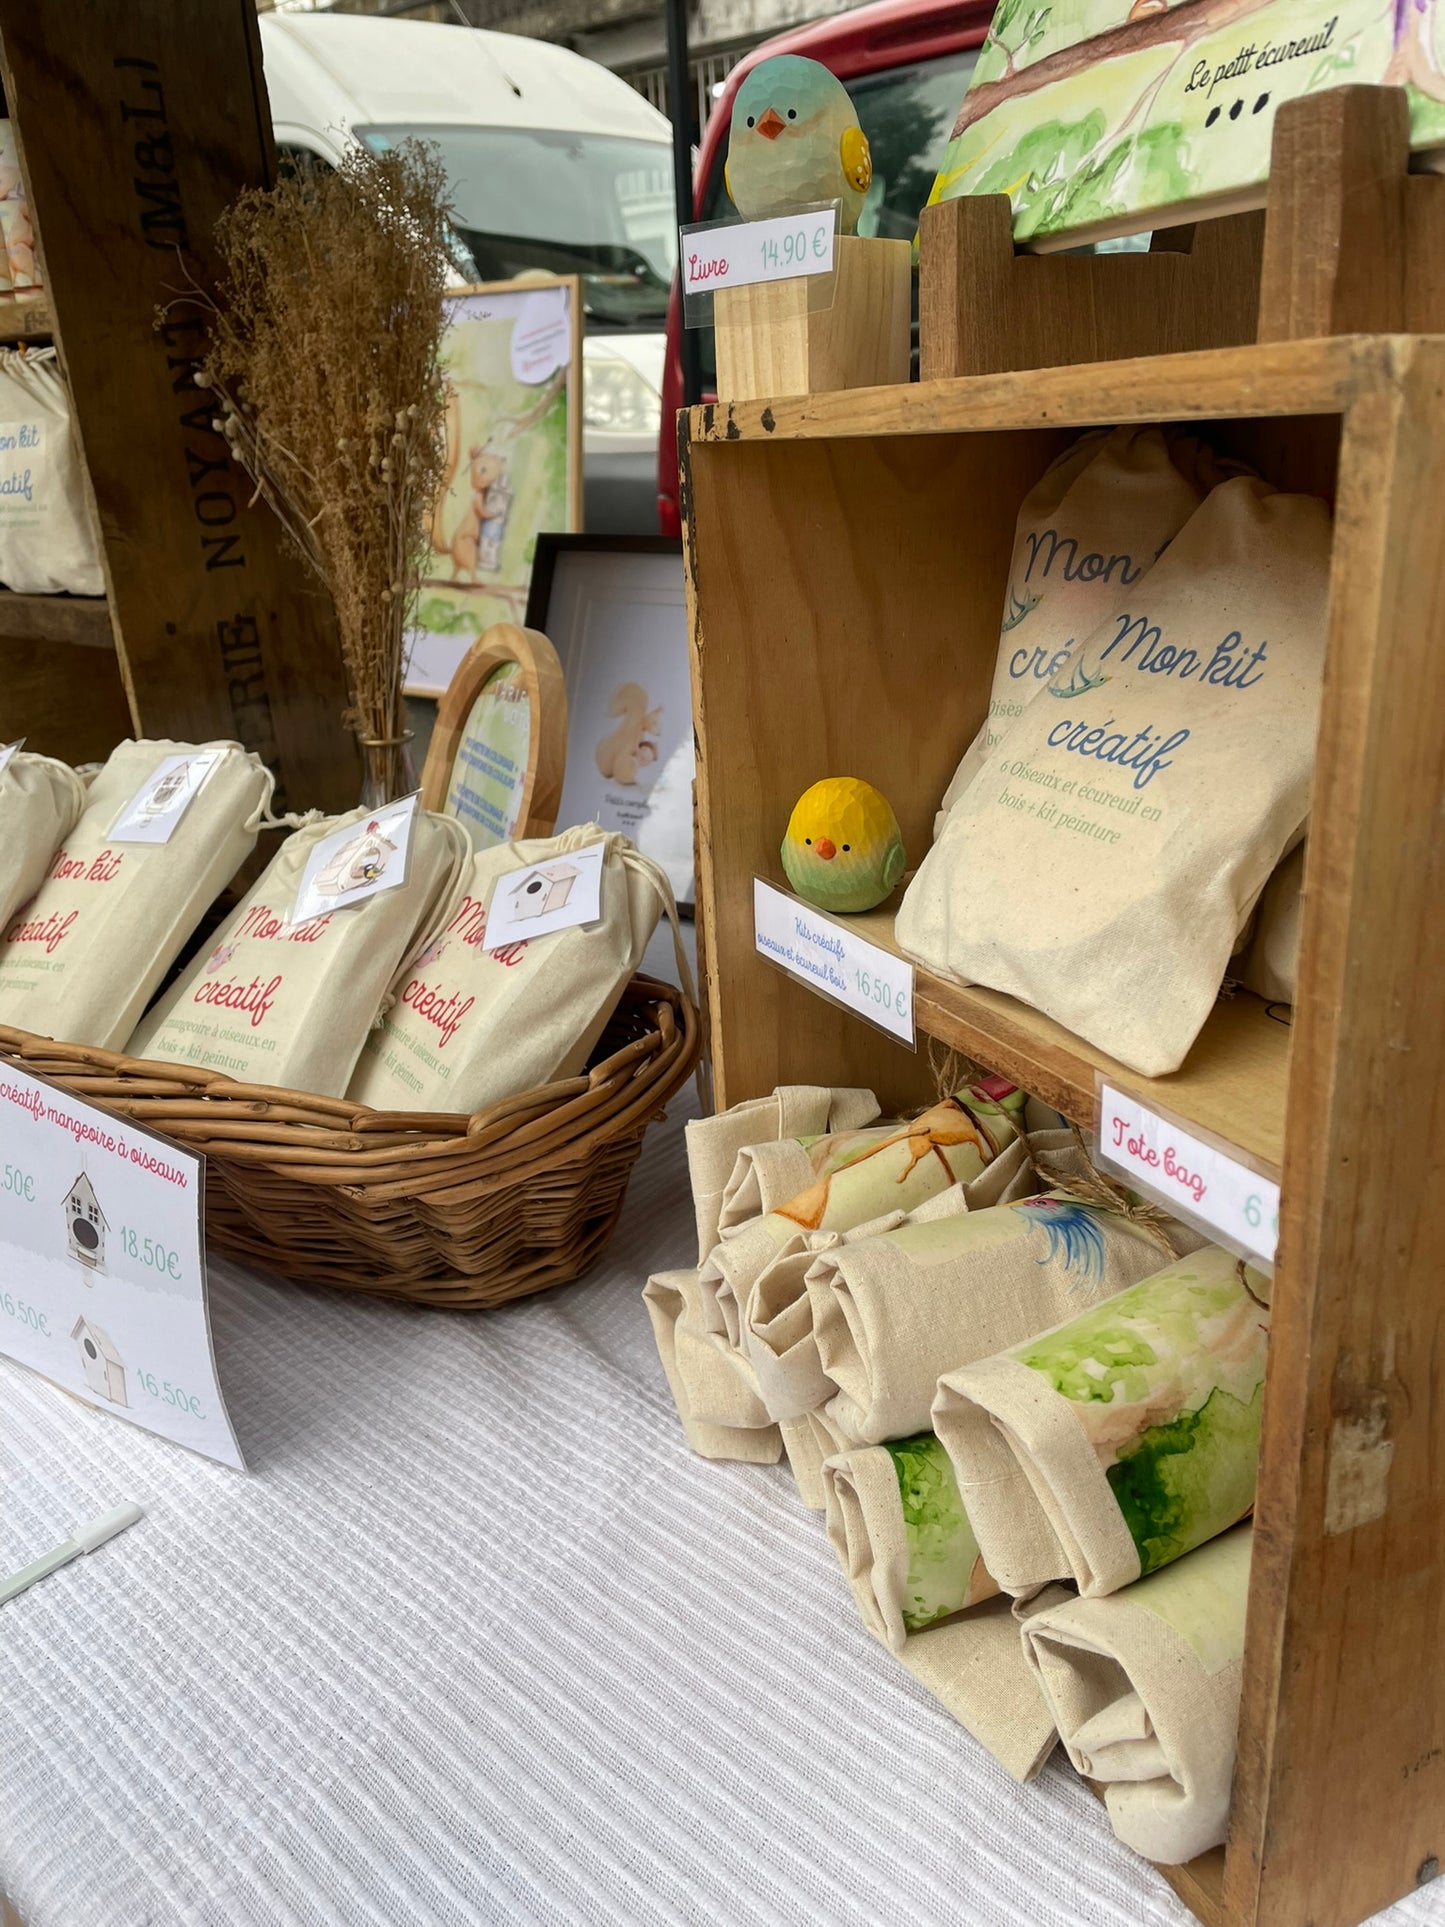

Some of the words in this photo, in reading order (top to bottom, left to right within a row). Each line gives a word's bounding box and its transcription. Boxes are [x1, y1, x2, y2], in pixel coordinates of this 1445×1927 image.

[1184, 59, 1211, 93] Le
[1206, 43, 1258, 99] petit
[1255, 16, 1338, 70] écureuil
[688, 254, 729, 282] Livre
[761, 231, 806, 270] 14.90
[812, 226, 827, 258] €
[160, 316, 247, 573] NOYANT
[1025, 529, 1141, 586] Mon
[1099, 613, 1201, 678] Mon
[1199, 631, 1268, 689] kit
[1047, 718, 1191, 790] créatif
[999, 787, 1026, 811] bois
[1027, 803, 1036, 814] +
[1036, 801, 1056, 821] kit
[1055, 814, 1121, 845] peinture
[1000, 760, 1008, 772] 6
[1009, 761, 1062, 790] Oiseaux
[1061, 780, 1076, 795] et
[1077, 780, 1144, 815] écureuil
[1140, 806, 1162, 823] en
[84, 849, 124, 881] kit
[757, 933, 786, 957] oiseaux
[786, 946, 795, 962] et
[795, 951, 829, 980] écureuil
[828, 967, 847, 991] bois
[795, 916, 812, 941] Kits
[812, 933, 845, 962] créatifs
[194, 975, 282, 1027] créatif
[402, 979, 475, 1048] créatif
[855, 969, 891, 1009] 16.50
[895, 991, 907, 1018] €
[157, 1036, 178, 1053] bois
[186, 1043, 202, 1060] kit
[200, 1050, 248, 1072] peinture
[211, 1024, 220, 1038] à
[220, 1026, 262, 1048] oiseaux
[261, 1039, 277, 1053] en
[438, 1062, 451, 1080] en
[0, 1082, 46, 1121] créatifs
[47, 1106, 116, 1153] mangeoire
[117, 1135, 129, 1159] à
[130, 1147, 188, 1188] oiseaux
[1163, 1147, 1208, 1203] bag
[1243, 1193, 1263, 1229] 6
[120, 1226, 182, 1280] 18.50€
[136, 1368, 207, 1420] 16.50€
